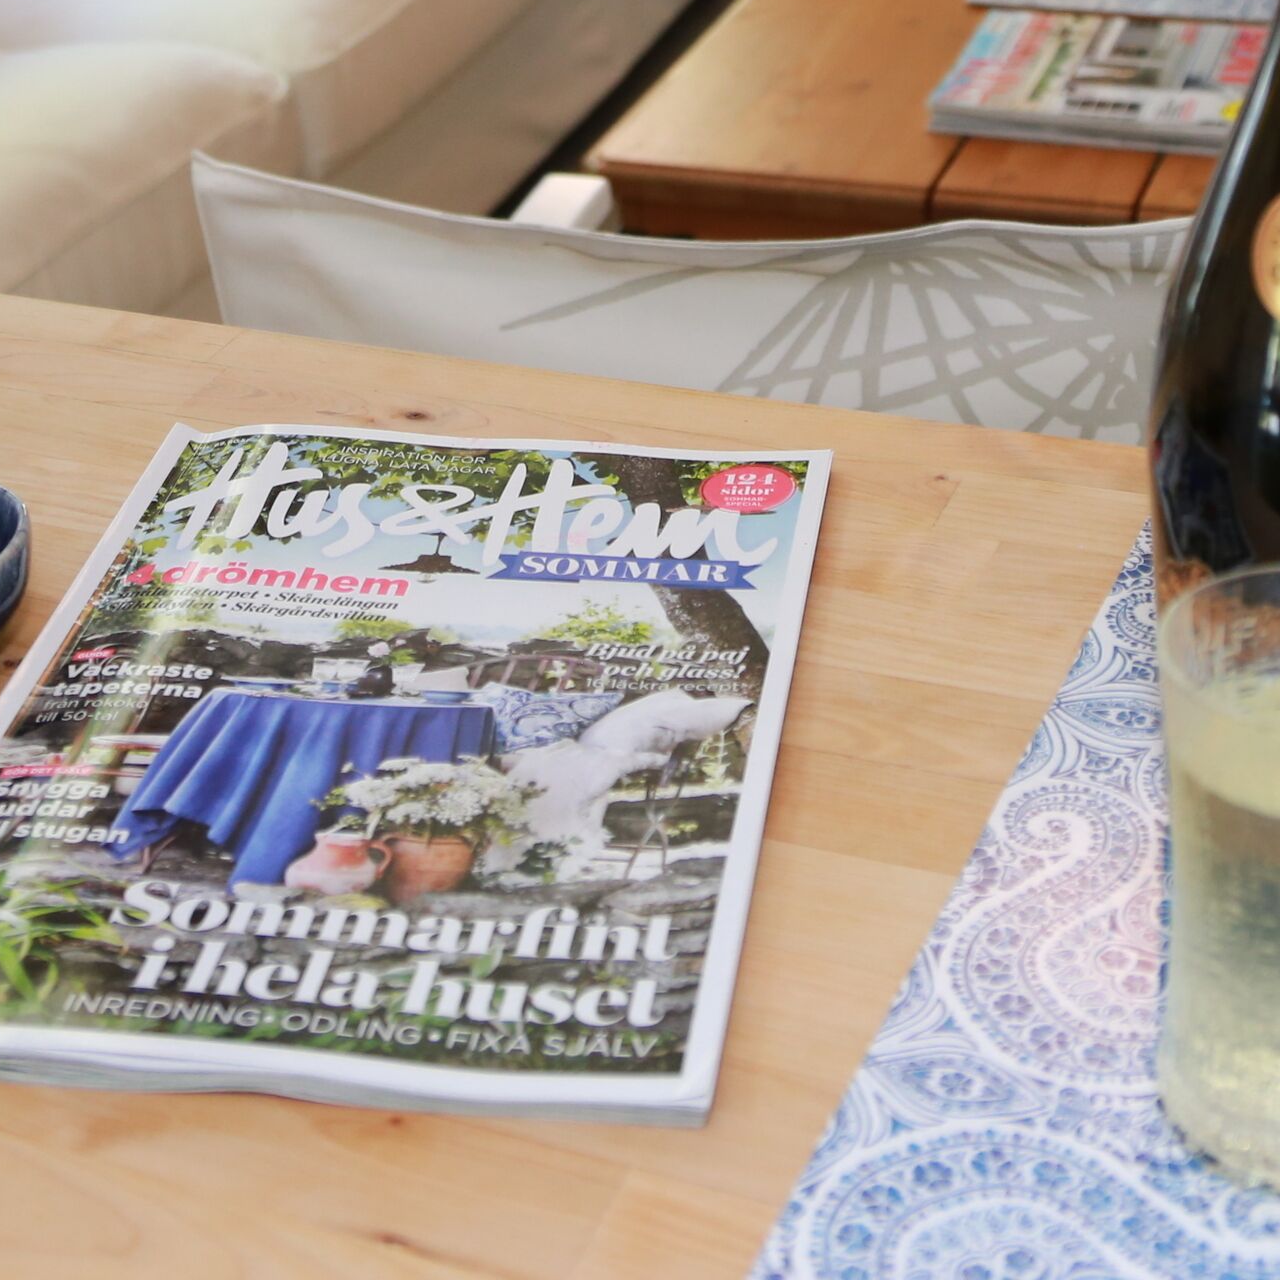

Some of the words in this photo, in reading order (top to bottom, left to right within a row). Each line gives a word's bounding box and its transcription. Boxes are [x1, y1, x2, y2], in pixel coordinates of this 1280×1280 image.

[436, 464, 496, 475] DAGAR
[724, 473, 778, 485] 124
[719, 486, 774, 496] sidor
[164, 441, 375, 558] Hus
[379, 484, 476, 546] &
[455, 459, 779, 567] Hem
[161, 561, 410, 598] drömhem
[519, 555, 730, 583] SOMMAR
[586, 642, 659, 660] Bjud
[658, 645, 696, 662] på
[697, 645, 751, 665] paj
[68, 661, 214, 680] Vackraste
[604, 662, 651, 679] och
[658, 662, 747, 682] glass!
[52, 680, 203, 700] tapeterna
[83, 698, 149, 709] rokoko
[35, 711, 59, 724] till
[61, 710, 120, 722] 50-tal
[12, 821, 131, 844] stugan
[109, 880, 680, 963] Sommarfint
[131, 936, 176, 991] i
[180, 940, 387, 1011] hela
[397, 959, 668, 1028] huset
[62, 993, 262, 1027] INREDNING
[280, 1011, 421, 1046] ODLING
[444, 1027, 532, 1056] FIXA
[541, 1032, 660, 1058] SJÄLV
